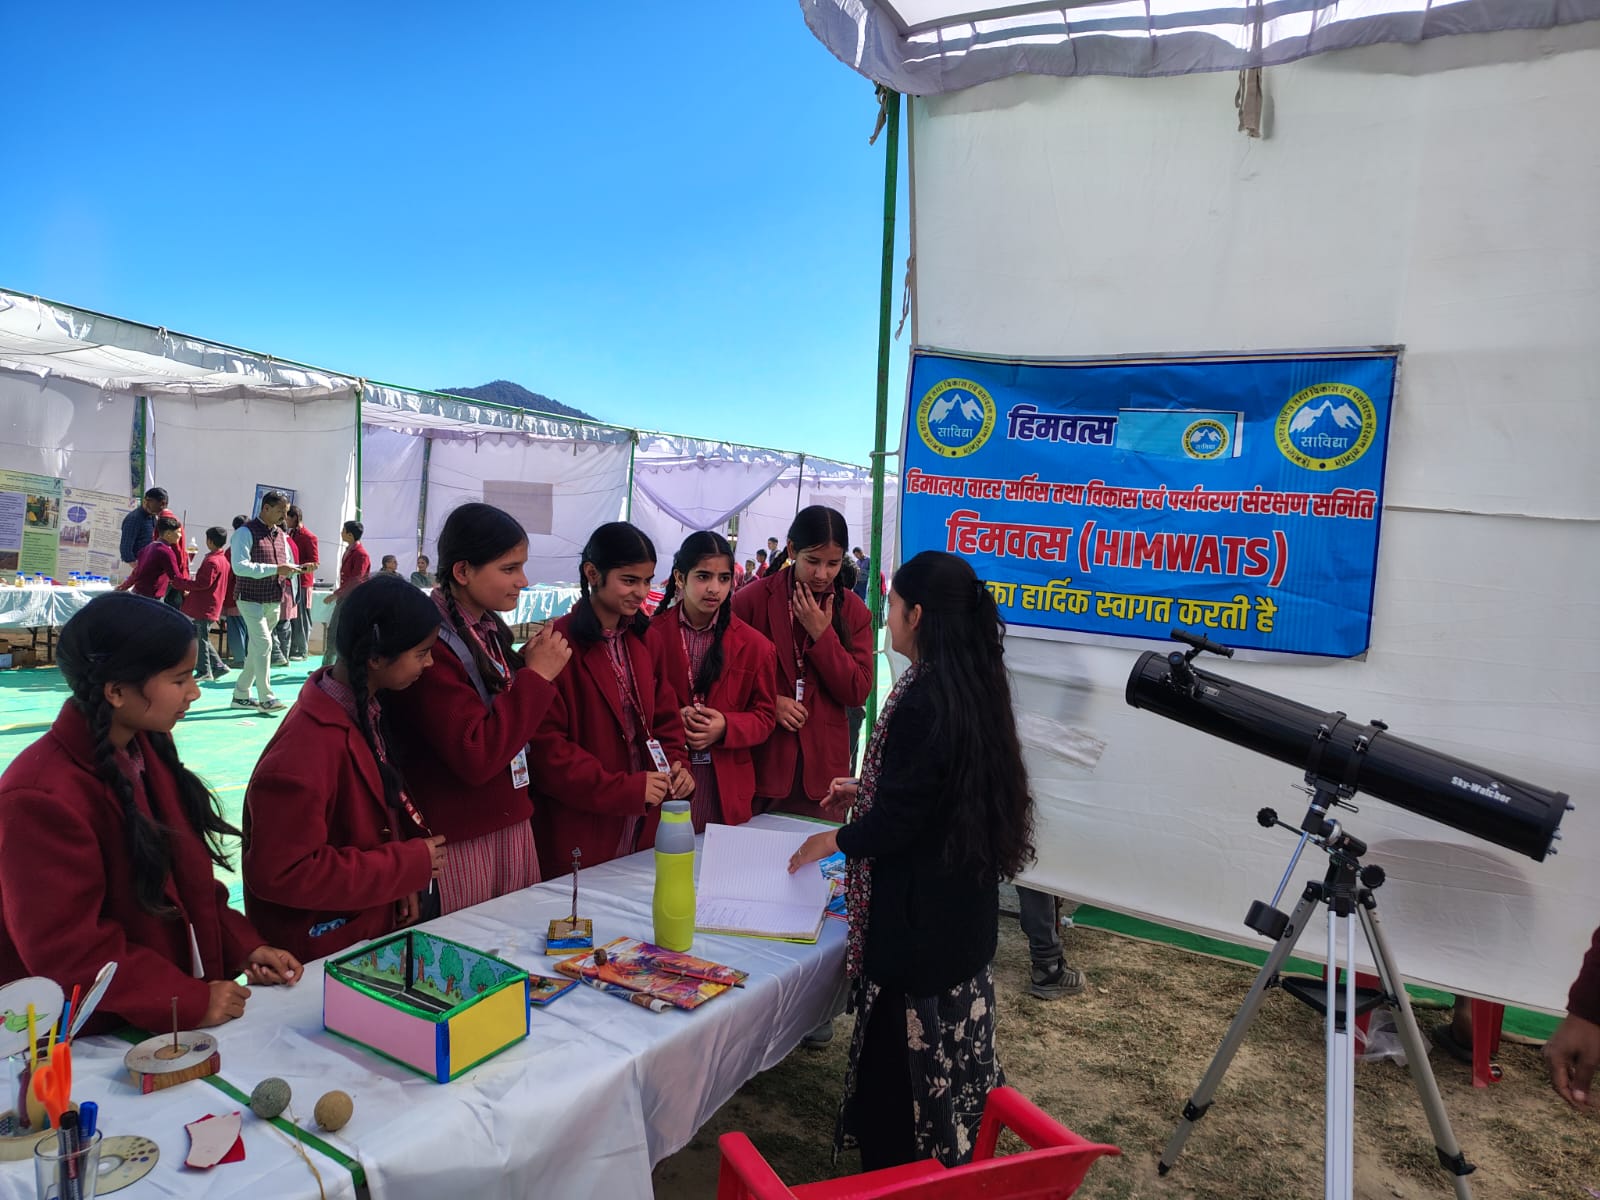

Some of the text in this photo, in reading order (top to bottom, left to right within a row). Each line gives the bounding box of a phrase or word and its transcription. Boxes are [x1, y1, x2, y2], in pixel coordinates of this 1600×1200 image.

[937, 424, 973, 438] साविद्या
[1007, 403, 1118, 446] हिमवत्स
[1301, 432, 1348, 448] साविद्या
[906, 468, 1377, 519] हिमालय वाटर सर्विस तथा विकास एवं पर्यावरण संरक्षण समिति
[946, 509, 1287, 587] हिमवत्स (HIMWATS)
[1021, 577, 1091, 614] हार्दिक
[1096, 590, 1173, 623] स्वागत
[1178, 595, 1251, 631] करती
[1255, 597, 1278, 633] है
